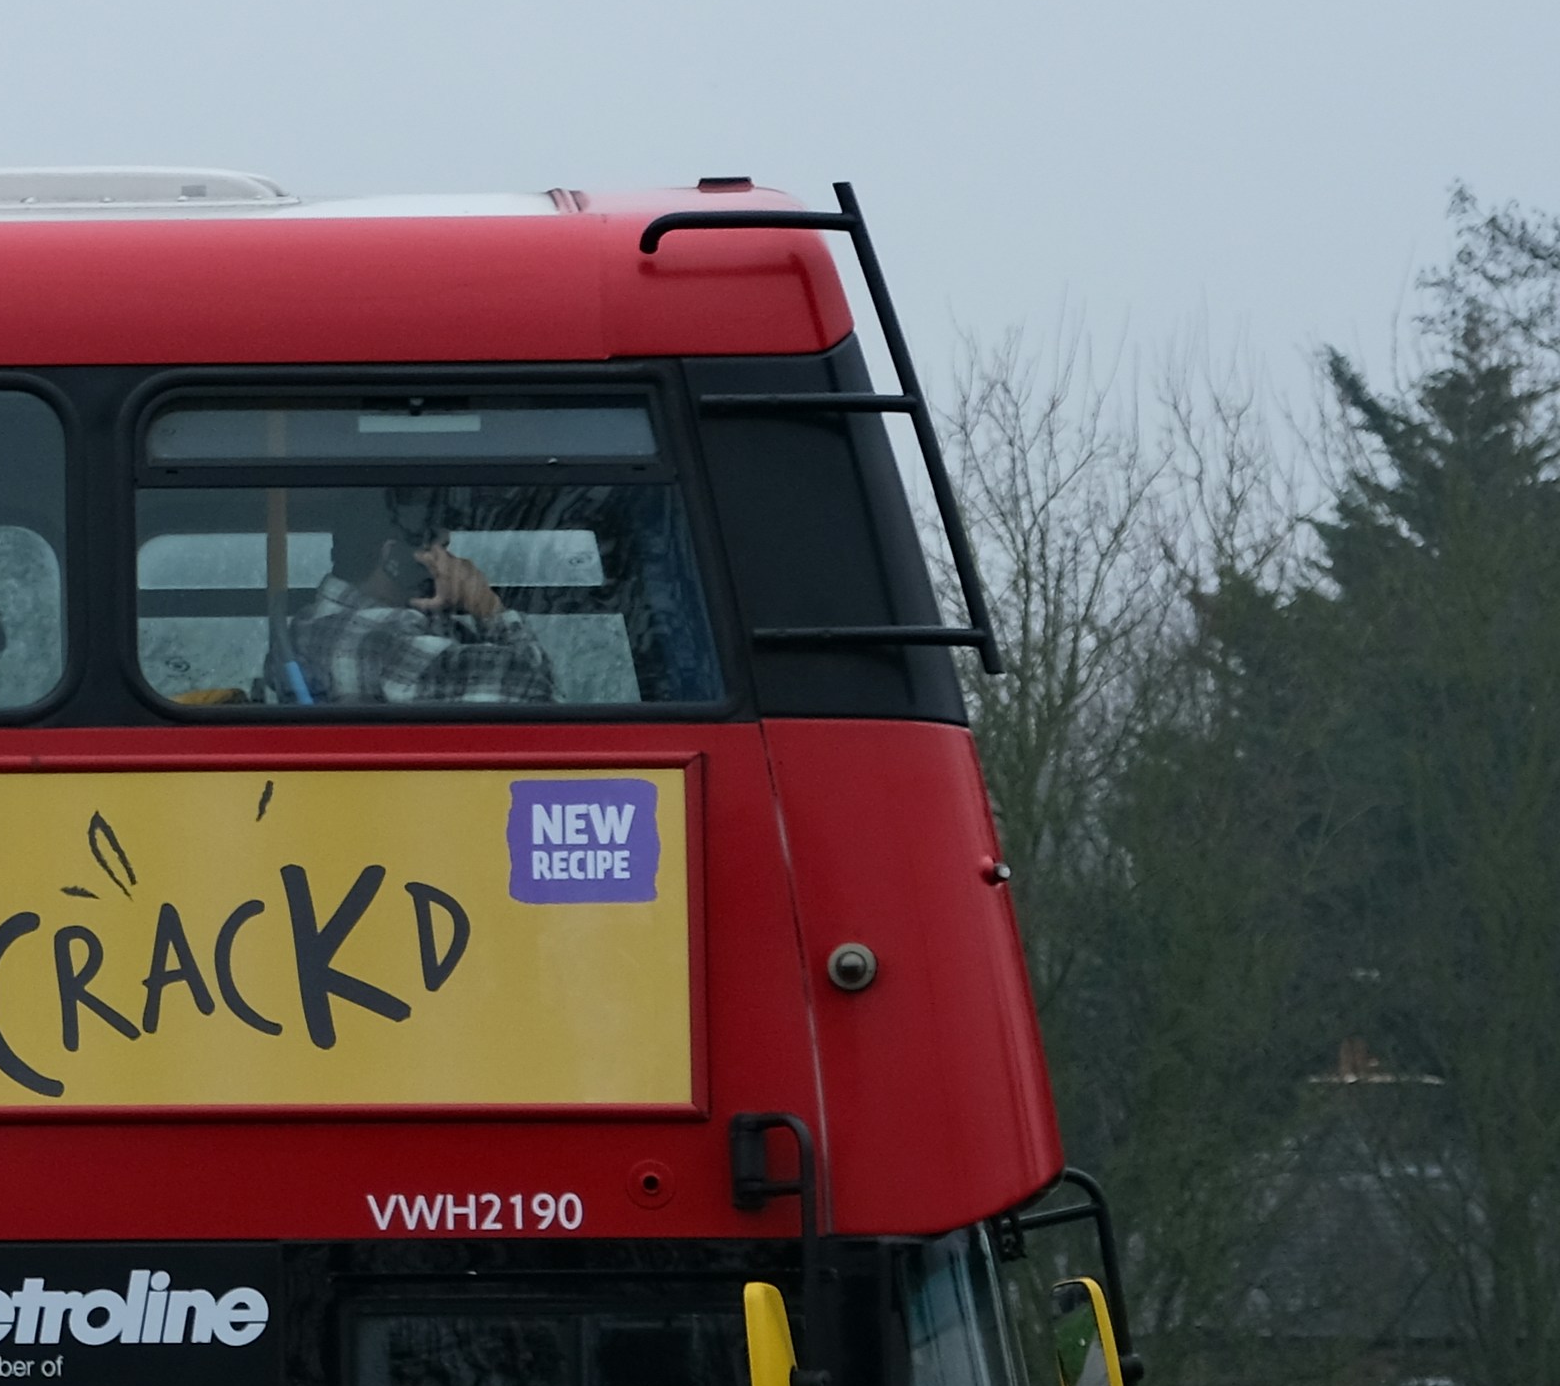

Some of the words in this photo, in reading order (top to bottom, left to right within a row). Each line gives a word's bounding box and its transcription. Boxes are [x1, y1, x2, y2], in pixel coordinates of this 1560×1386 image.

[530, 802, 636, 847] NEW
[530, 849, 632, 882] RECIPE
[367, 1192, 584, 1232] VWH2190
[39, 1354, 65, 1378] of
